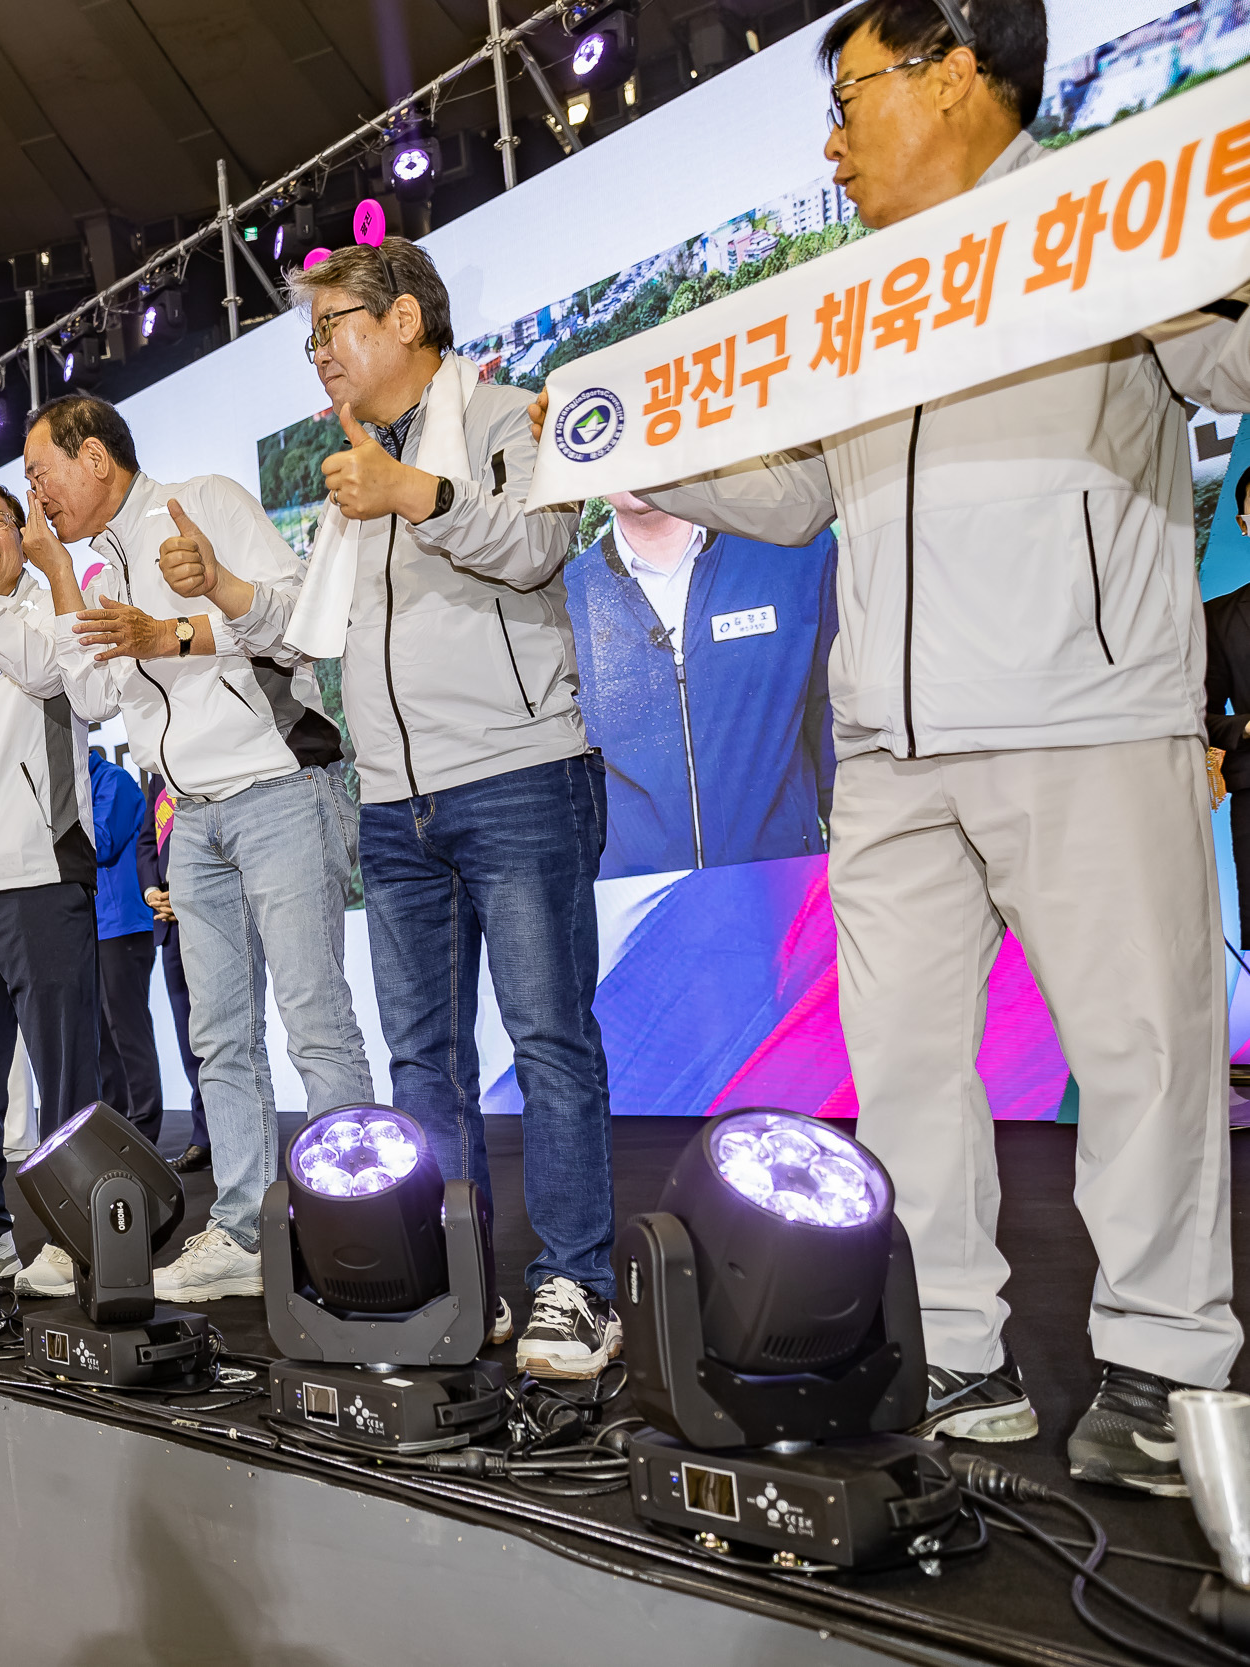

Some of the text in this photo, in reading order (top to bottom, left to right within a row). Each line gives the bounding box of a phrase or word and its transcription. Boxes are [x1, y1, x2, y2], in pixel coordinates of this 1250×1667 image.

[642, 314, 792, 448] 광진구
[808, 222, 1008, 378] 체육회
[116, 1201, 126, 1231] ORION-6
